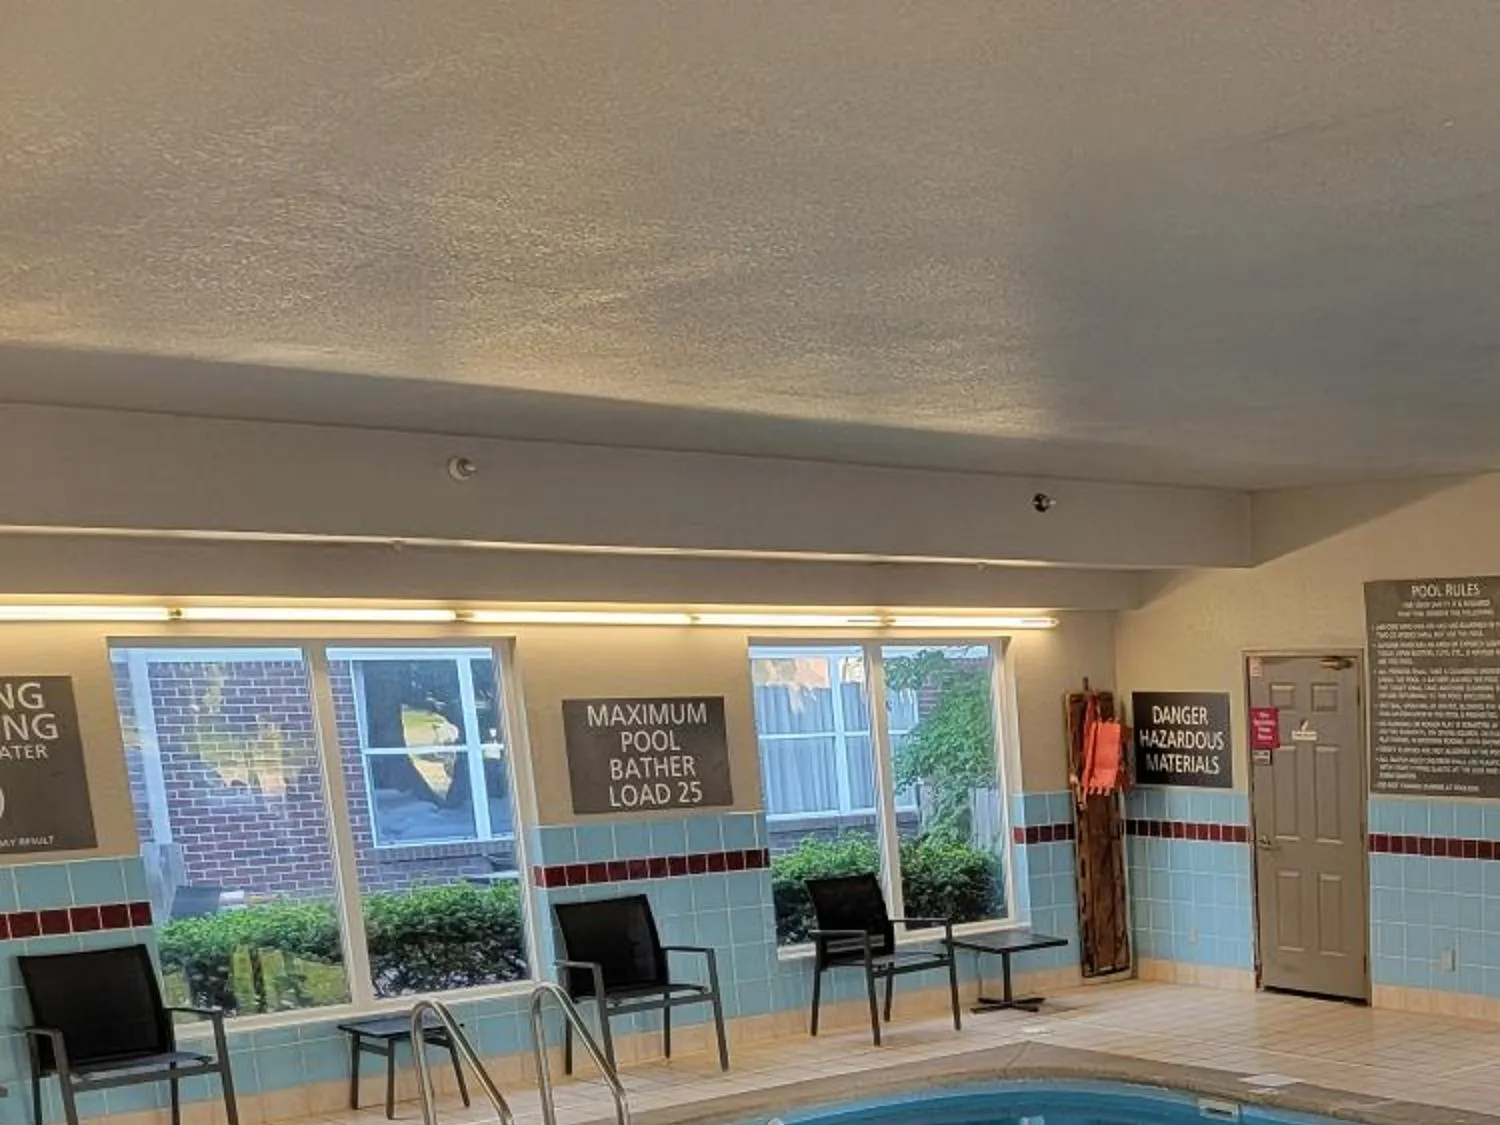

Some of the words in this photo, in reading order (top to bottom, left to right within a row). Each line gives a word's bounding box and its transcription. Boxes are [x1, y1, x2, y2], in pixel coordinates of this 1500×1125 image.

[1411, 585, 1442, 598] POOL
[1445, 583, 1481, 597] RULES
[587, 702, 707, 728] MAXIMUM
[1152, 705, 1209, 726] DANGER
[2, 713, 60, 741] NG
[621, 730, 681, 752] POOL
[1139, 729, 1225, 751] HAZARDOUS
[610, 756, 696, 780] BATHER
[1147, 753, 1220, 775] MATERIALS
[609, 783, 671, 807] LOAD
[678, 781, 703, 804] 25
